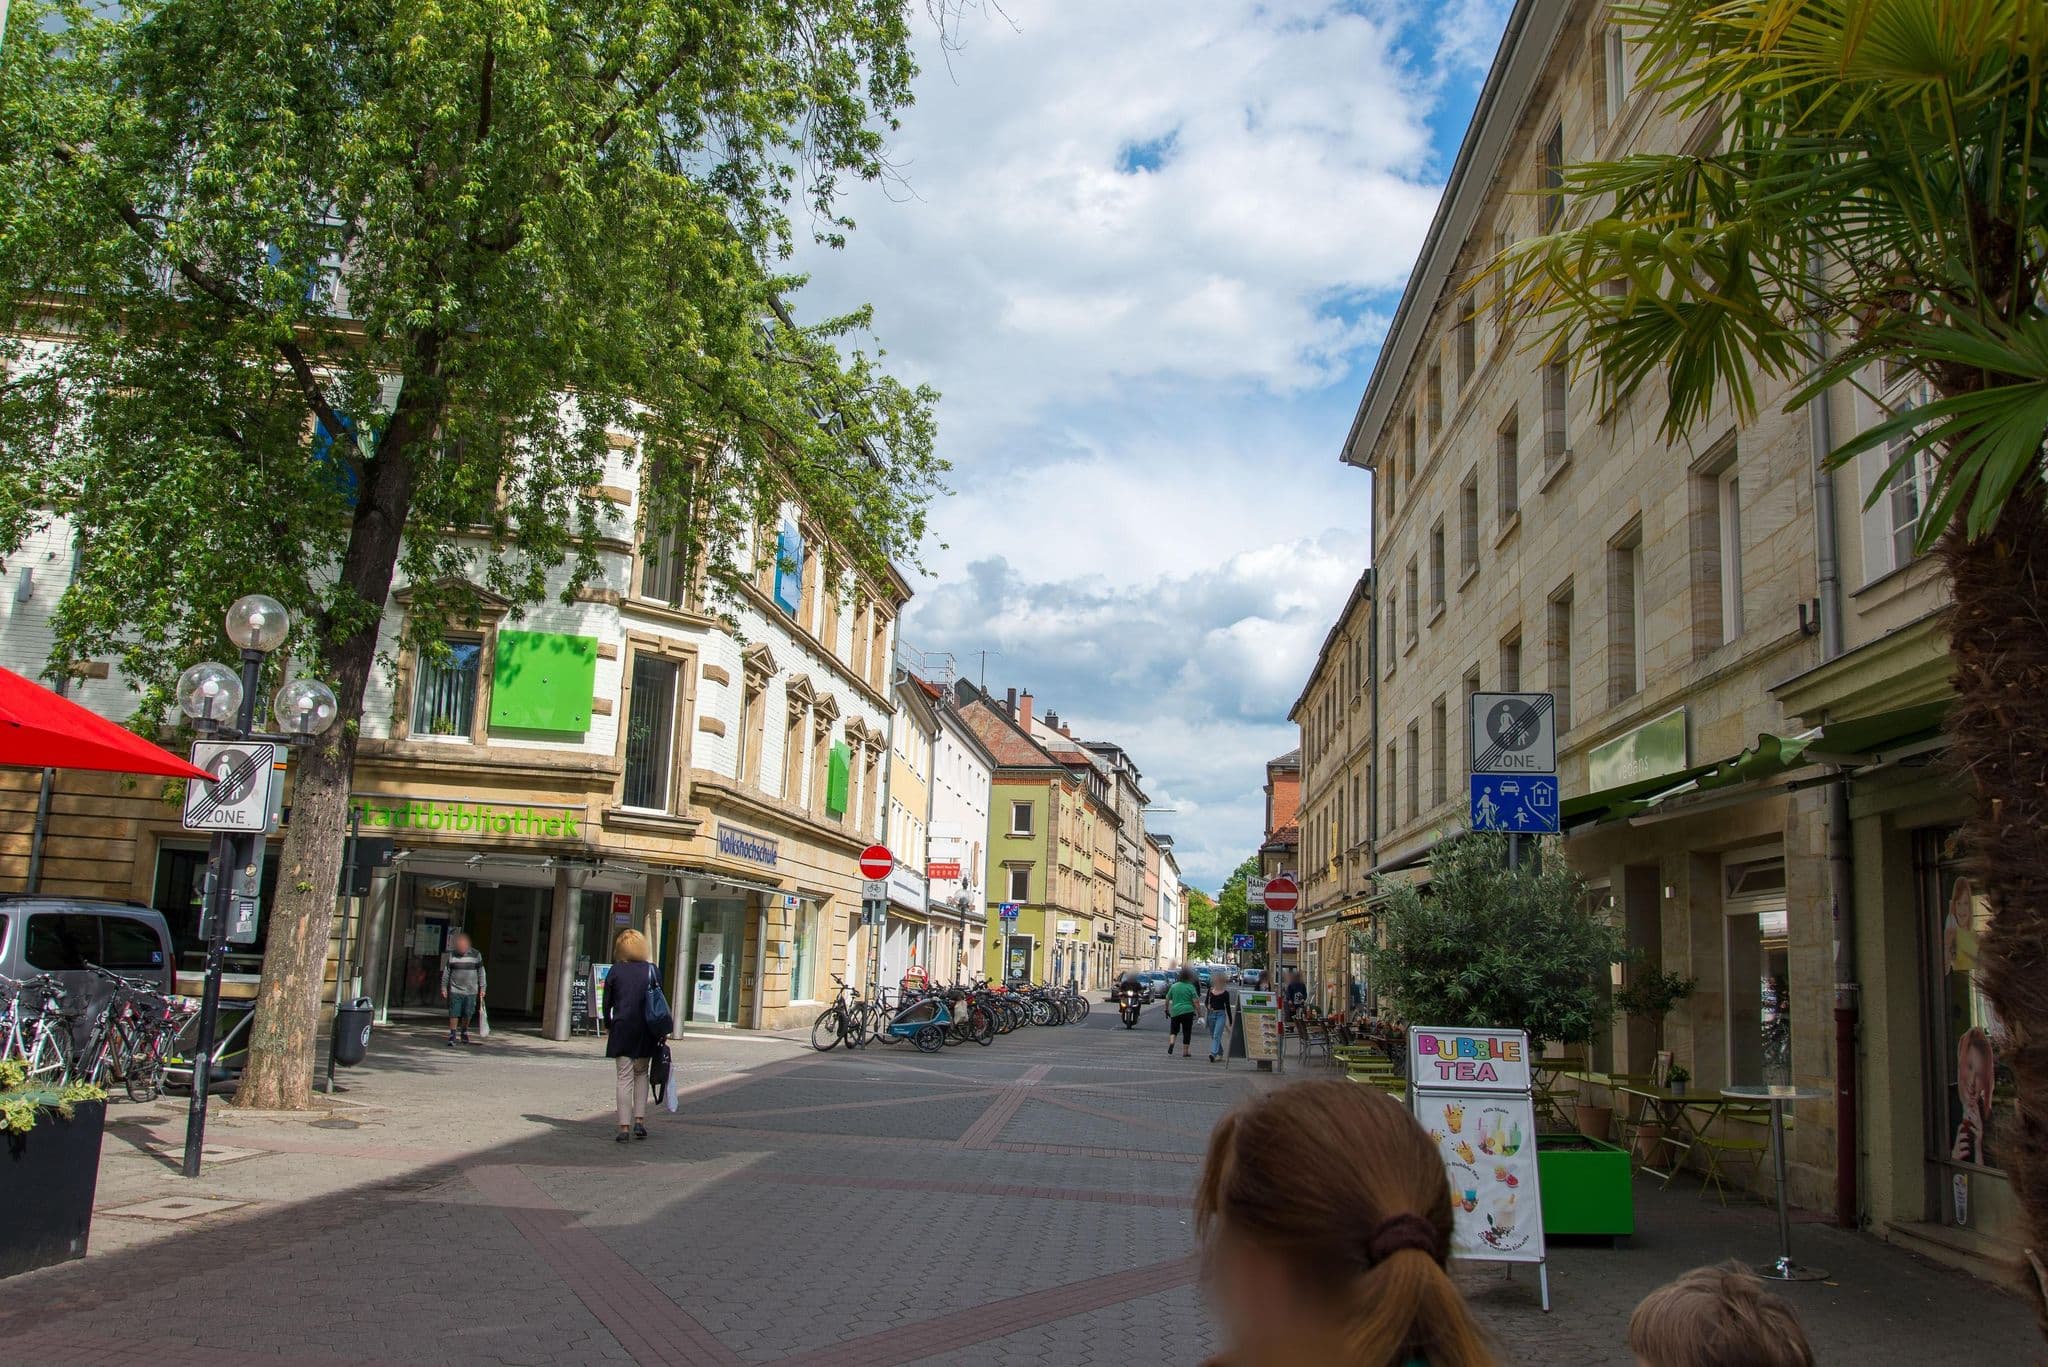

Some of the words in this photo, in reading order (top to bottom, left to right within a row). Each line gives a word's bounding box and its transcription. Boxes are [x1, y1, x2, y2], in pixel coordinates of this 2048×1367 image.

[1494, 754, 1535, 767] ZONE
[720, 829, 777, 866] Volkshochschule
[1418, 1034, 1521, 1062] BUBBLE
[1434, 1061, 1498, 1081] TEA
